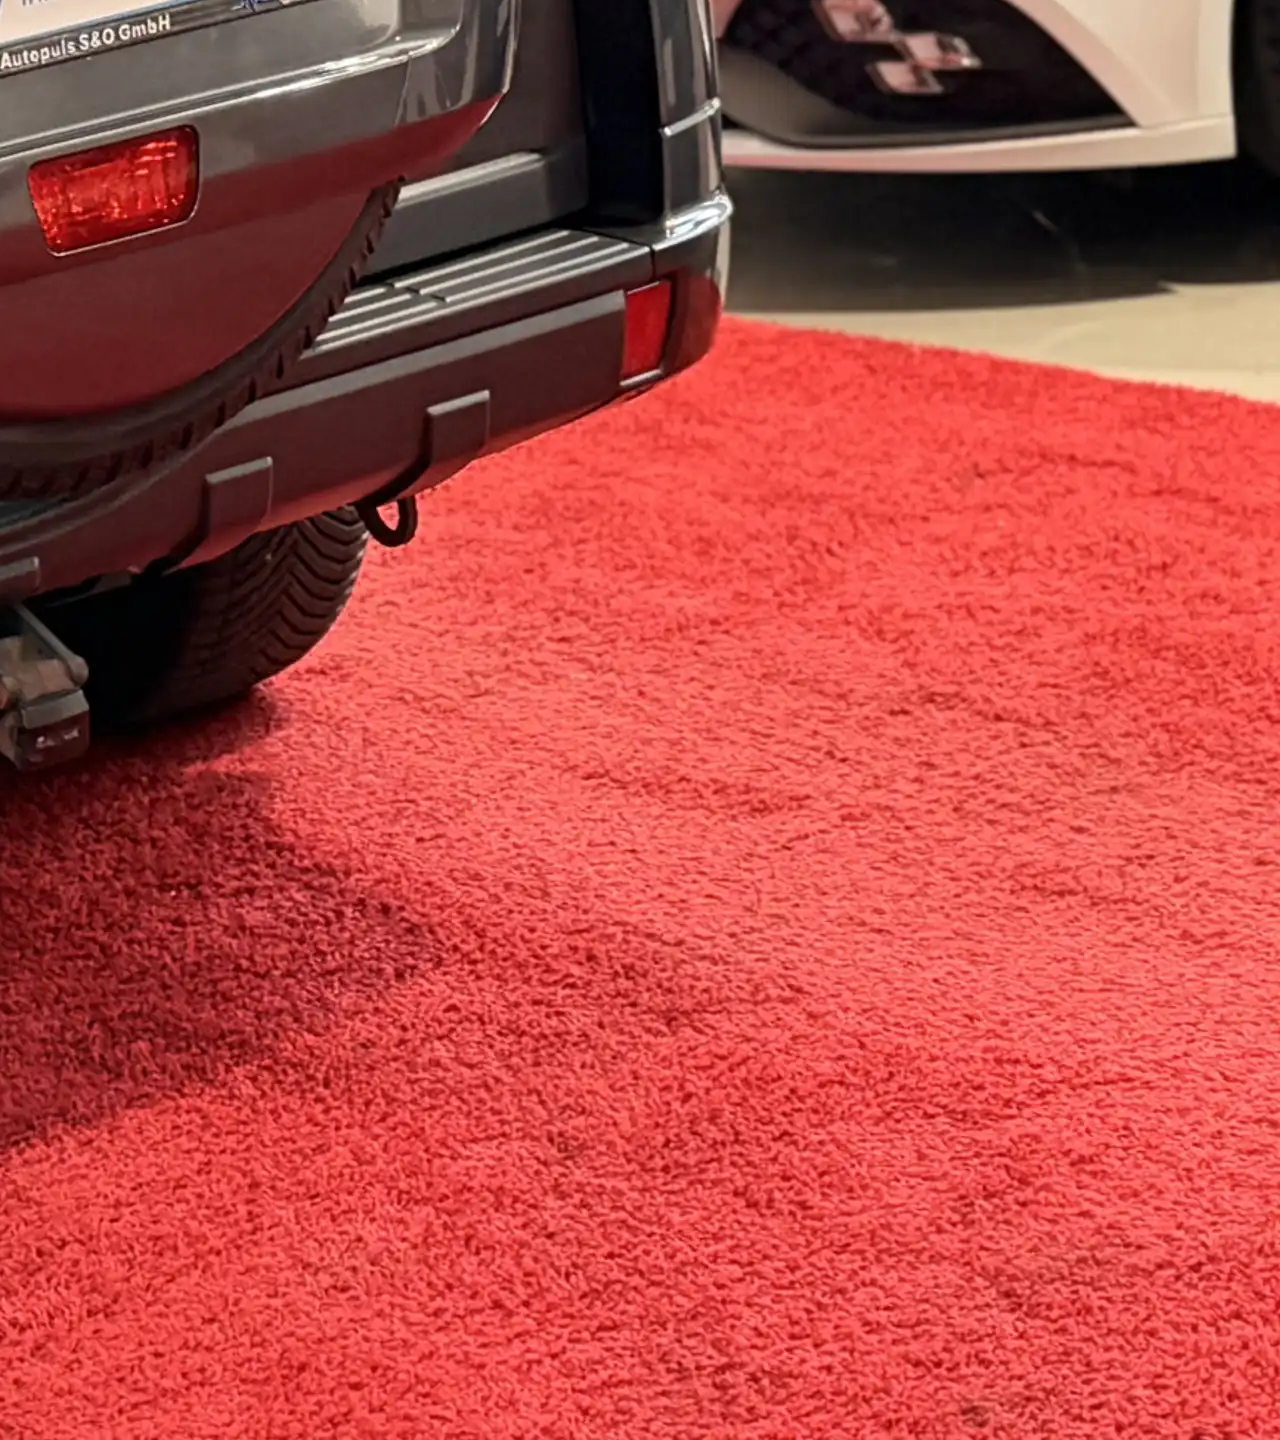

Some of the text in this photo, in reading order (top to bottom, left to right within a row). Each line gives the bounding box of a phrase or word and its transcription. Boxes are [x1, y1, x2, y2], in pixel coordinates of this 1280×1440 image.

[0, 13, 172, 70] Autopuls S&O GmbH
